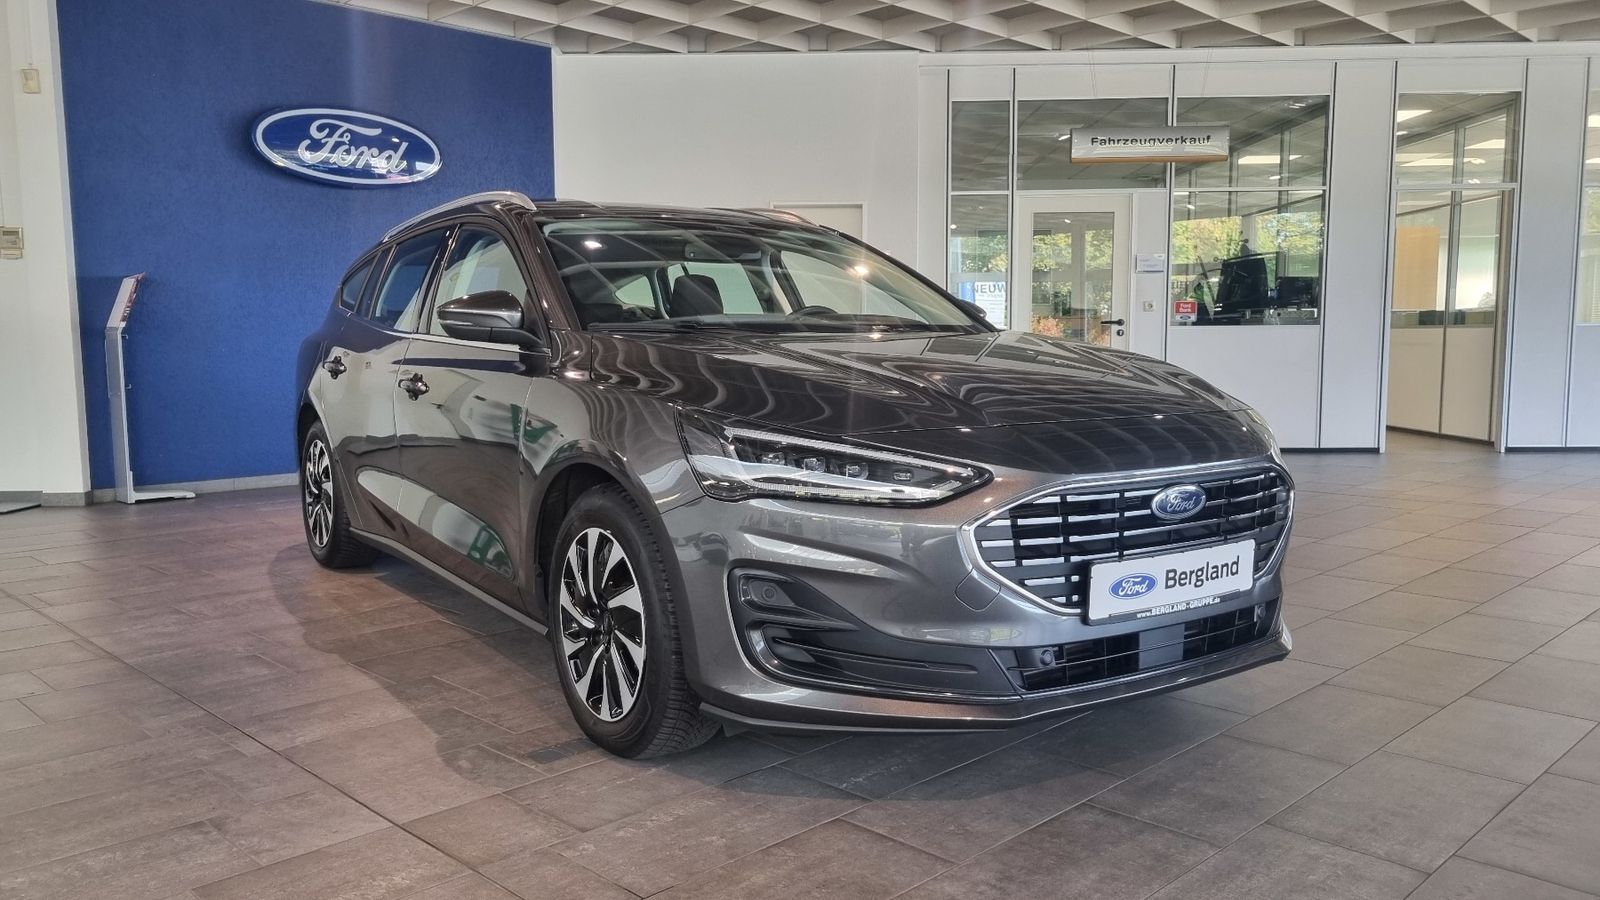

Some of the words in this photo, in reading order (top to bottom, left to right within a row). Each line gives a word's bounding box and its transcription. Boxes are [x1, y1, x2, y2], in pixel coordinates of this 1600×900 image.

[297, 118, 409, 174] Ford
[1090, 135, 1212, 147] Fahrzeugverkauf
[1167, 492, 1196, 512] Ford
[1118, 577, 1149, 596] Ford
[1164, 555, 1240, 590] Bergland
[1136, 597, 1221, 619] www.BERGLAND-GRUPPE.de
